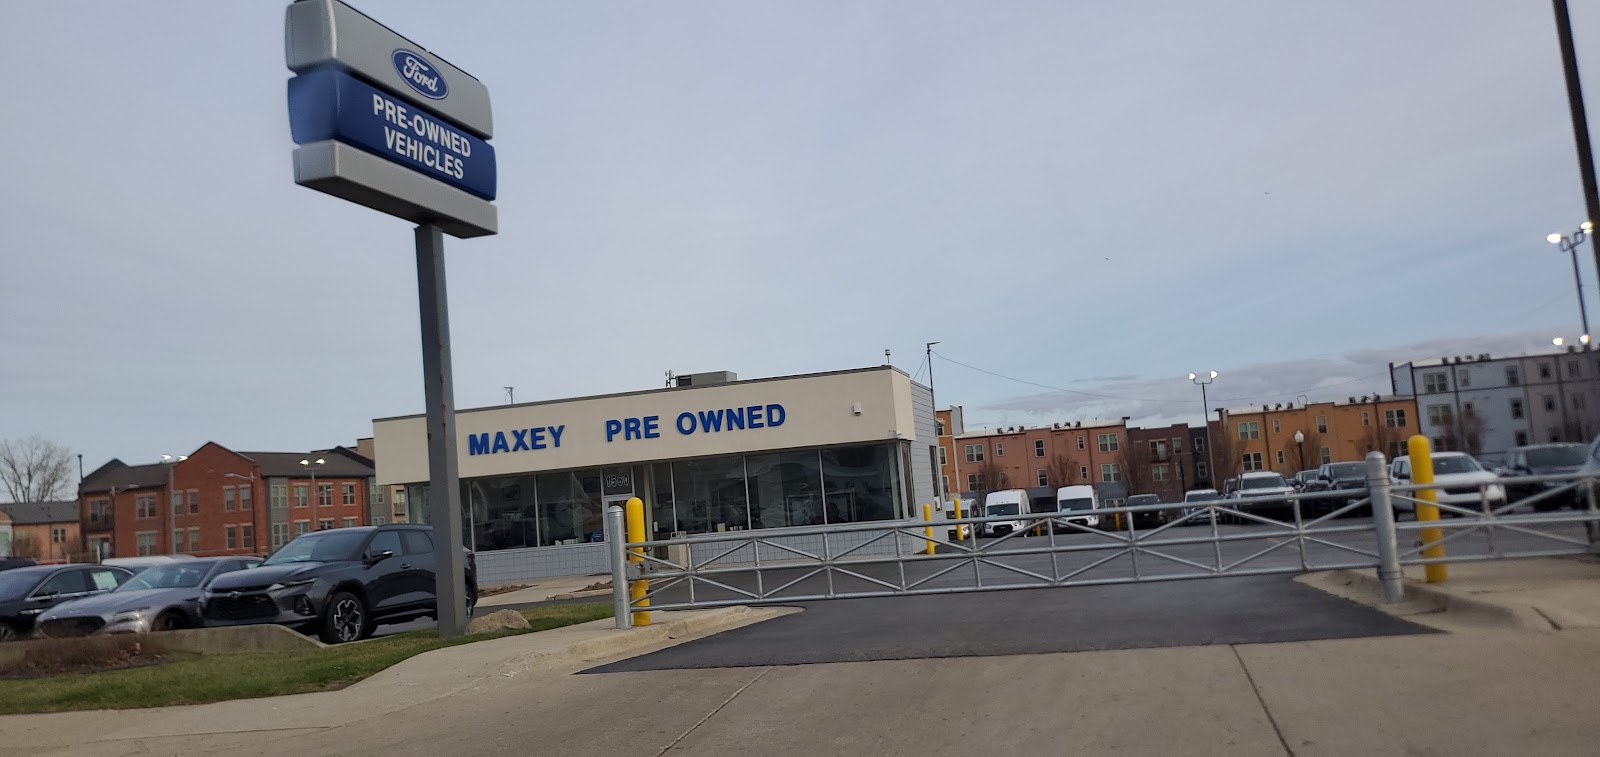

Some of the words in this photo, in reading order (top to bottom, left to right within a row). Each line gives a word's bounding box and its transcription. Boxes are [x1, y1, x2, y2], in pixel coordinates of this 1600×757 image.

[403, 56, 438, 92] Ford
[373, 94, 471, 158] PRE-OWNED
[384, 126, 464, 180] VEHICLES
[468, 424, 565, 456] MAXEY
[605, 415, 660, 442] PRE
[676, 403, 786, 435] OWNED
[605, 473, 630, 488] 1560
